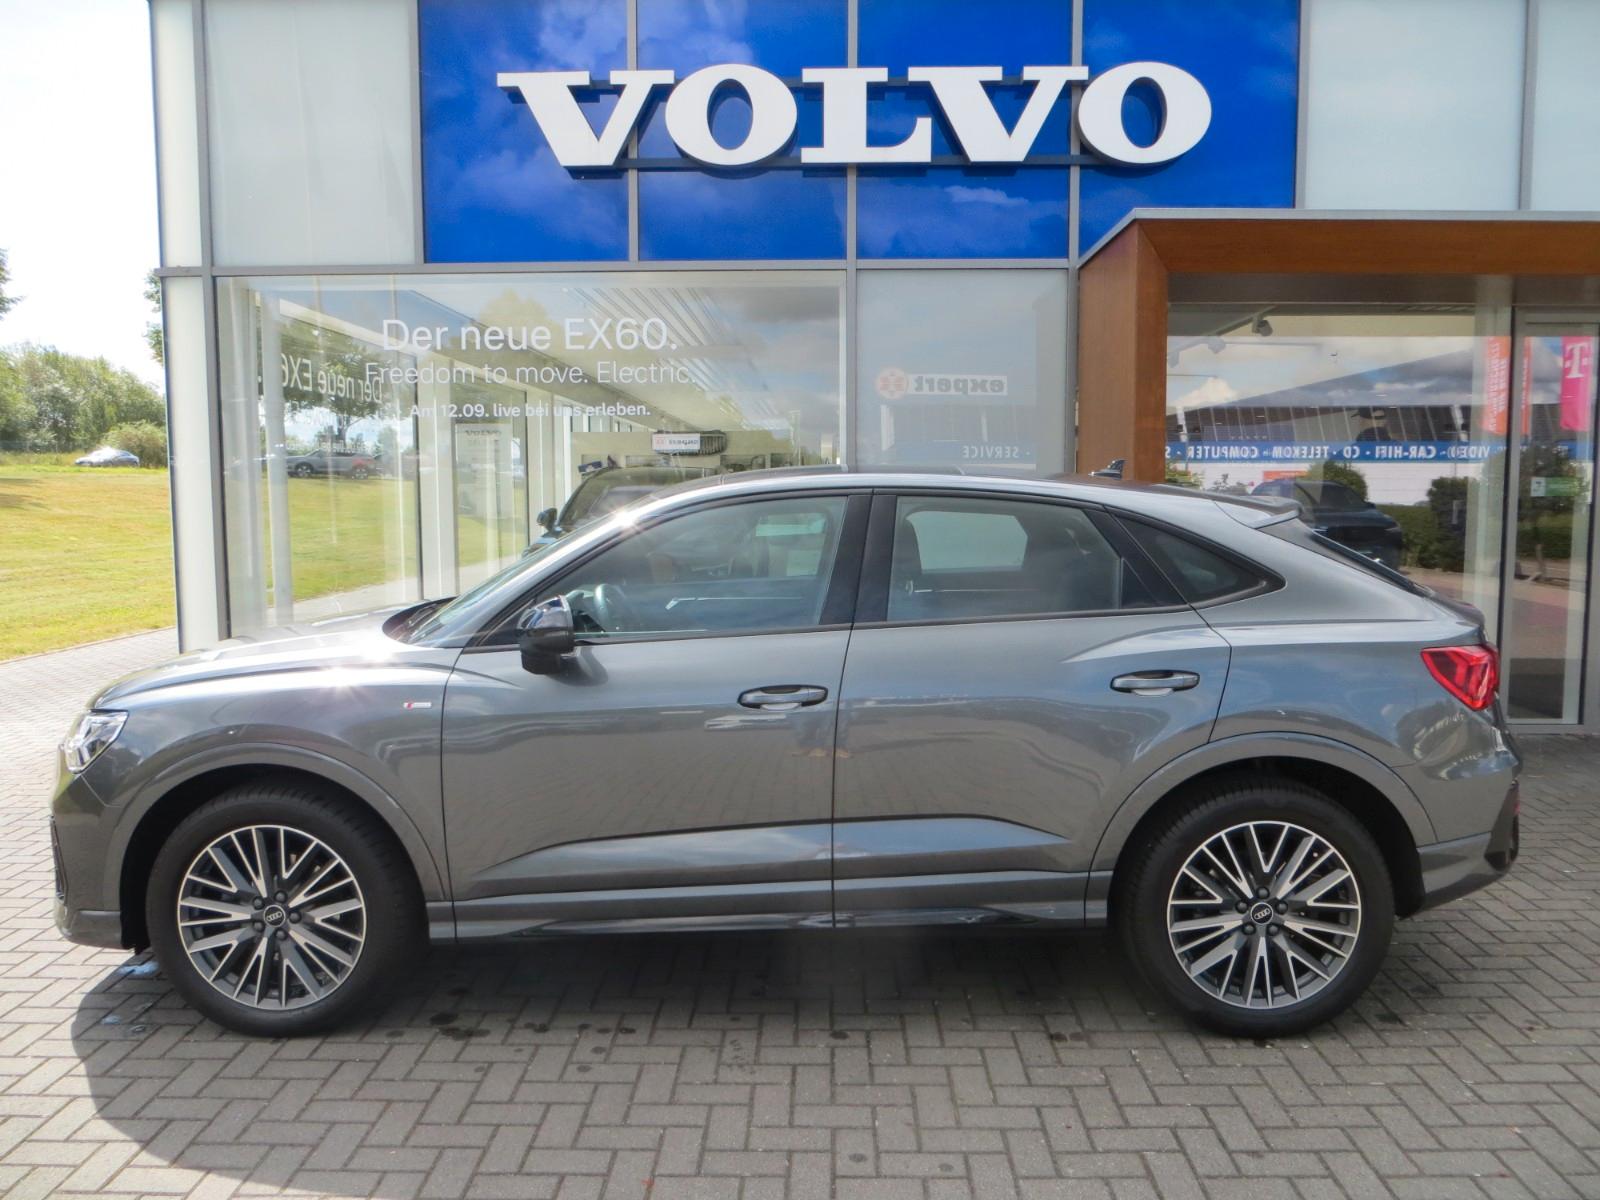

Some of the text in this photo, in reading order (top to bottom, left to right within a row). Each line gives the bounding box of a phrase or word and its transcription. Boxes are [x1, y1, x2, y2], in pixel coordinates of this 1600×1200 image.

[497, 61, 1212, 167] VOLVO
[383, 318, 677, 350] Der neue EX60.
[366, 361, 696, 384] Freedom to move. Electric.
[411, 402, 651, 418] Am 12.09. live bei uns erleben.
